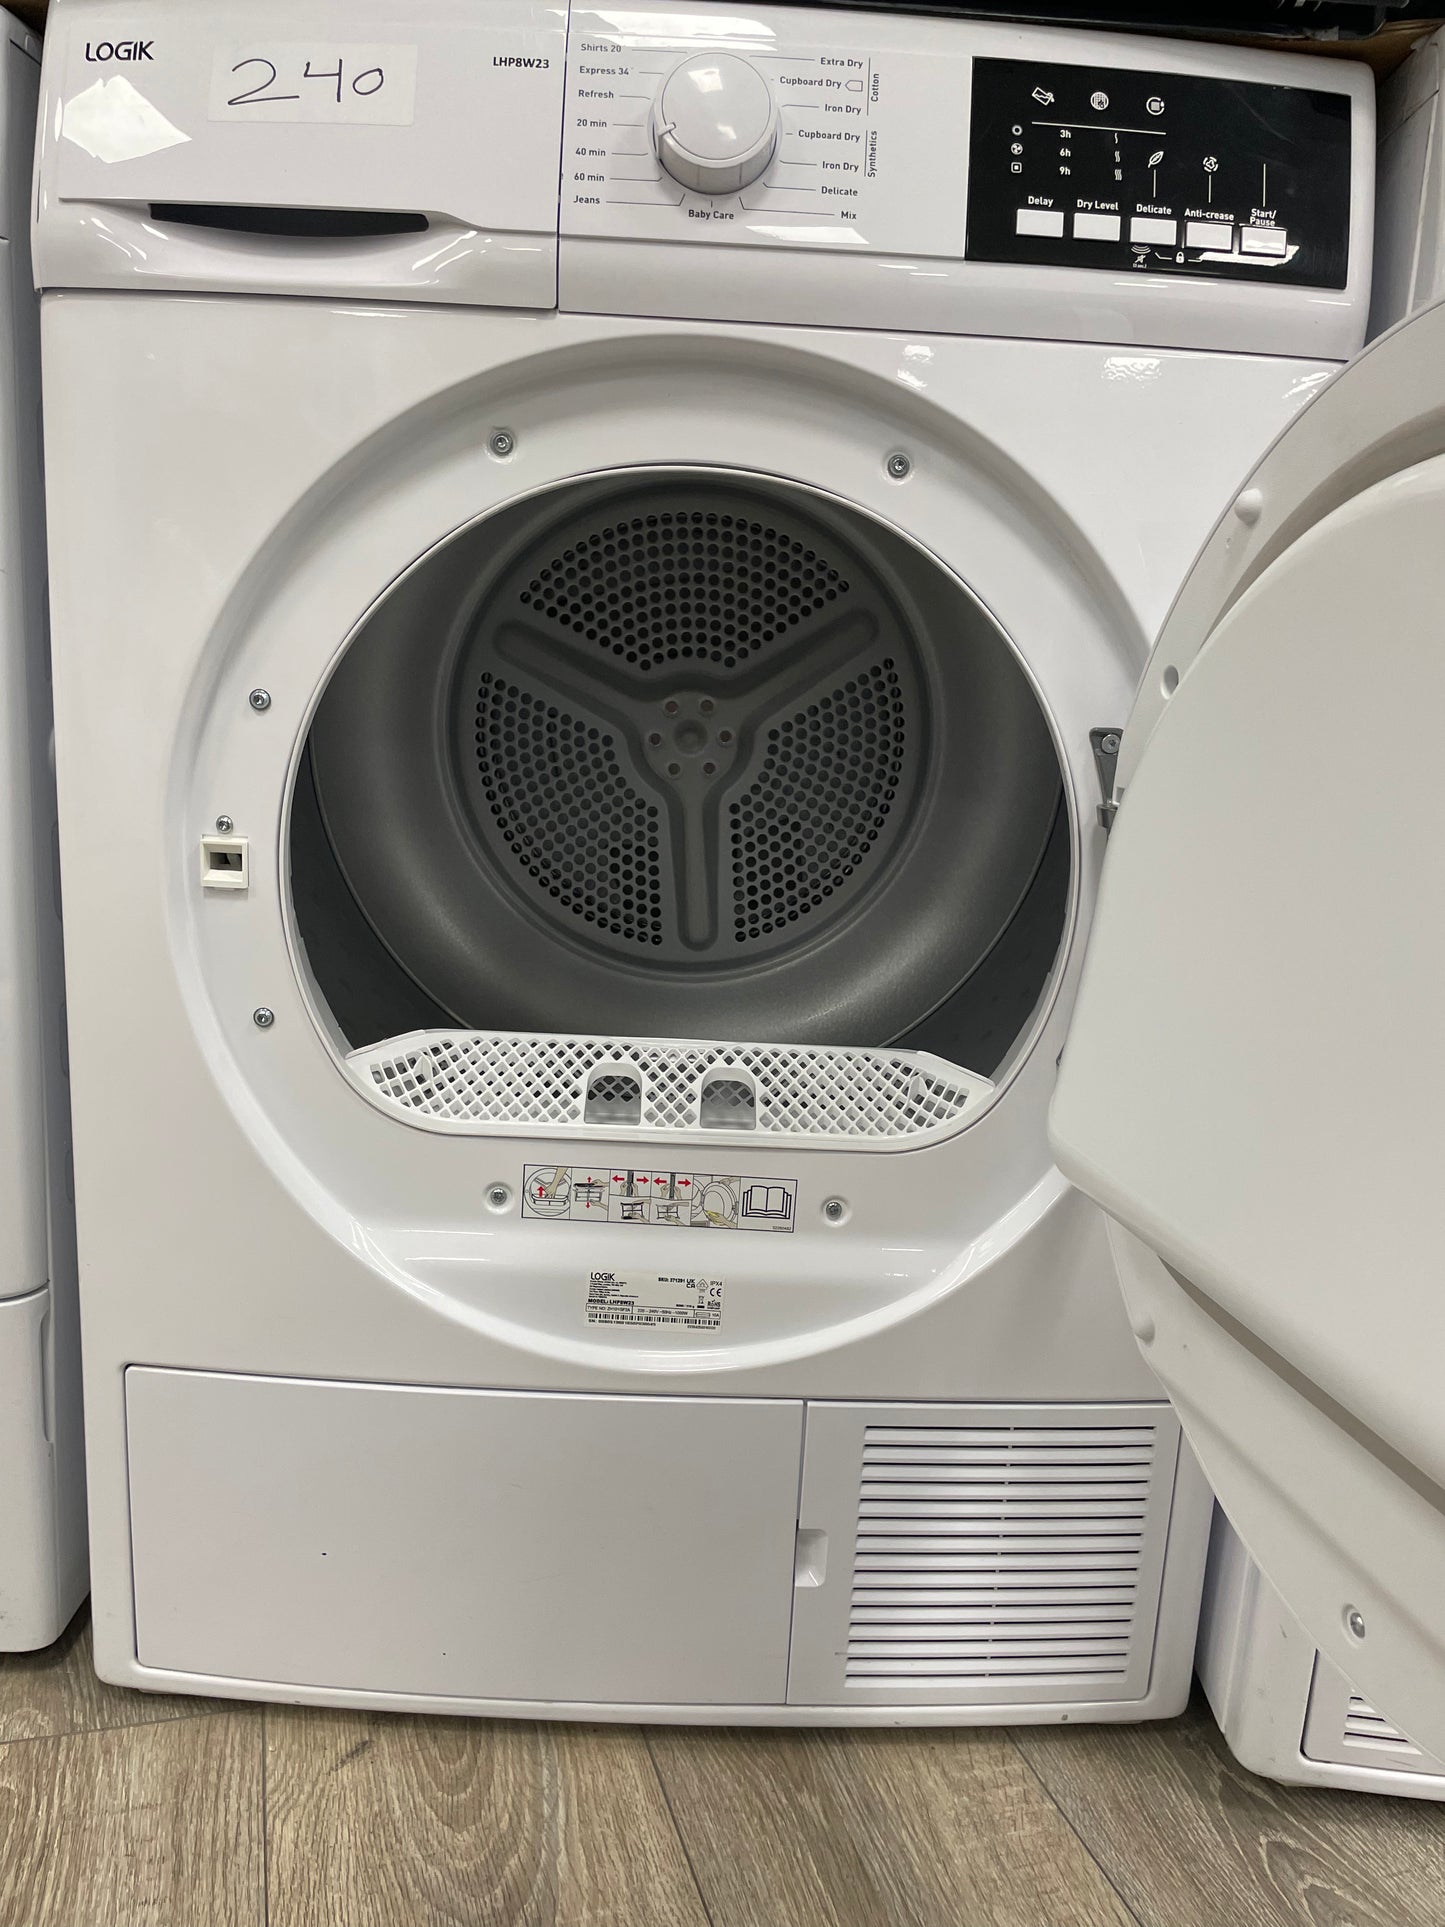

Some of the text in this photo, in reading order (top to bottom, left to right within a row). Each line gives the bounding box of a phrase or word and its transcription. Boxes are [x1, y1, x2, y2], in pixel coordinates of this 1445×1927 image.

[85, 41, 154, 62] LOGIK
[580, 43, 622, 53] Shirts 20
[493, 56, 550, 70] LHP8W23
[820, 57, 864, 69] Extra Dry
[579, 65, 629, 76] Express 34
[227, 58, 384, 106] 240
[779, 76, 842, 89] Cupboard Dry
[870, 73, 880, 102] Cotton
[578, 89, 614, 99] Refresh
[824, 104, 862, 116] Iron Dry
[576, 118, 607, 127] 20 min
[798, 129, 861, 143] Cupboard Dry
[1060, 129, 1072, 139] 3h
[575, 148, 606, 157] 40 min
[867, 130, 878, 178] Synthetics
[1059, 148, 1071, 157] 6h
[822, 161, 859, 172] Iron Dry
[1059, 166, 1071, 175] 9h
[573, 173, 605, 182] 60 min
[821, 186, 858, 197] Delicate
[573, 195, 601, 204] Jeans
[1028, 196, 1054, 207] Delay
[1077, 200, 1119, 211] Dry Level
[1136, 204, 1172, 215] Delicate
[688, 210, 735, 220] Baby Care
[840, 211, 857, 220] Mix
[1184, 208, 1234, 221] Anti-crease
[1251, 208, 1277, 219] Start/
[1250, 217, 1275, 227] Pause
[590, 1272, 615, 1281] LOGIK
